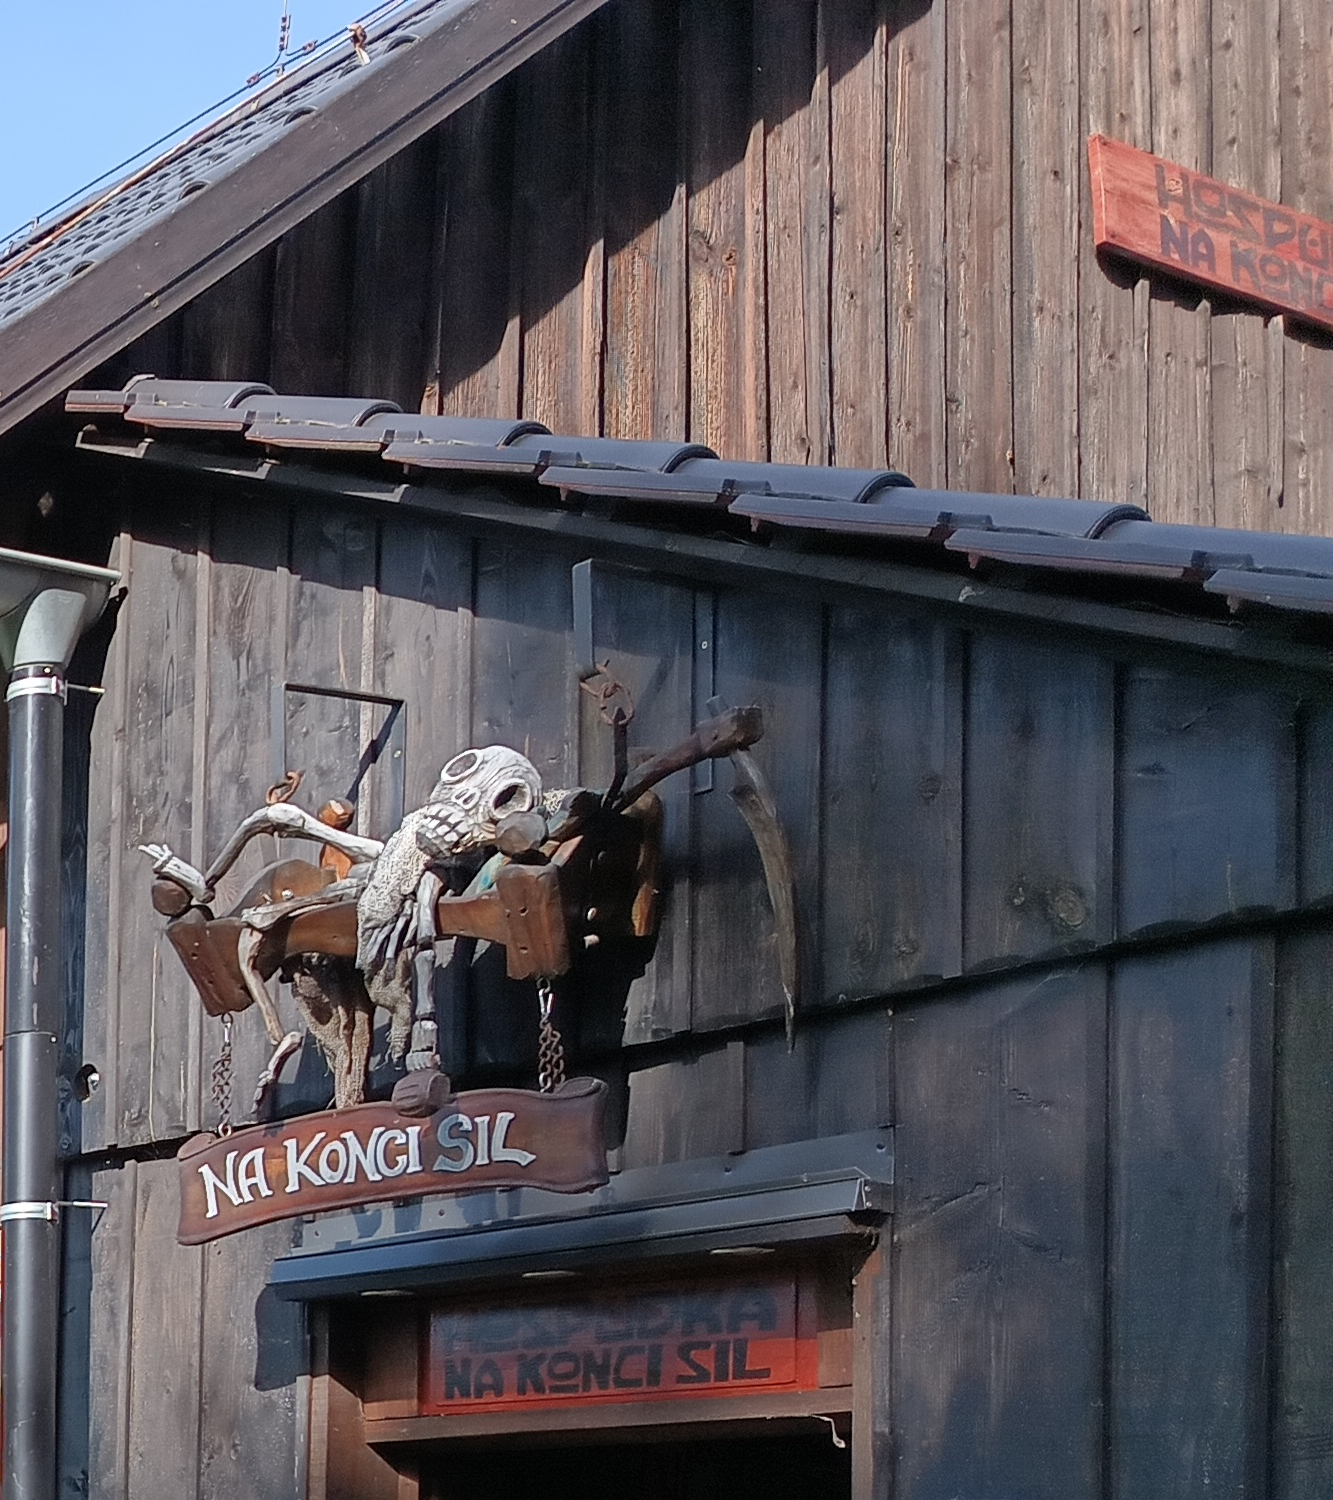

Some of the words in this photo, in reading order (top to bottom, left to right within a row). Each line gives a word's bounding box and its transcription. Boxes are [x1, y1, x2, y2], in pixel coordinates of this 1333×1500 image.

[1160, 212, 1216, 274] NA
[198, 1148, 273, 1219] NA
[282, 1126, 423, 1194] KONCI
[433, 1112, 536, 1173] SIL
[444, 1355, 504, 1399] NA
[516, 1343, 663, 1397] KONCI
[676, 1338, 771, 1384] SIL
